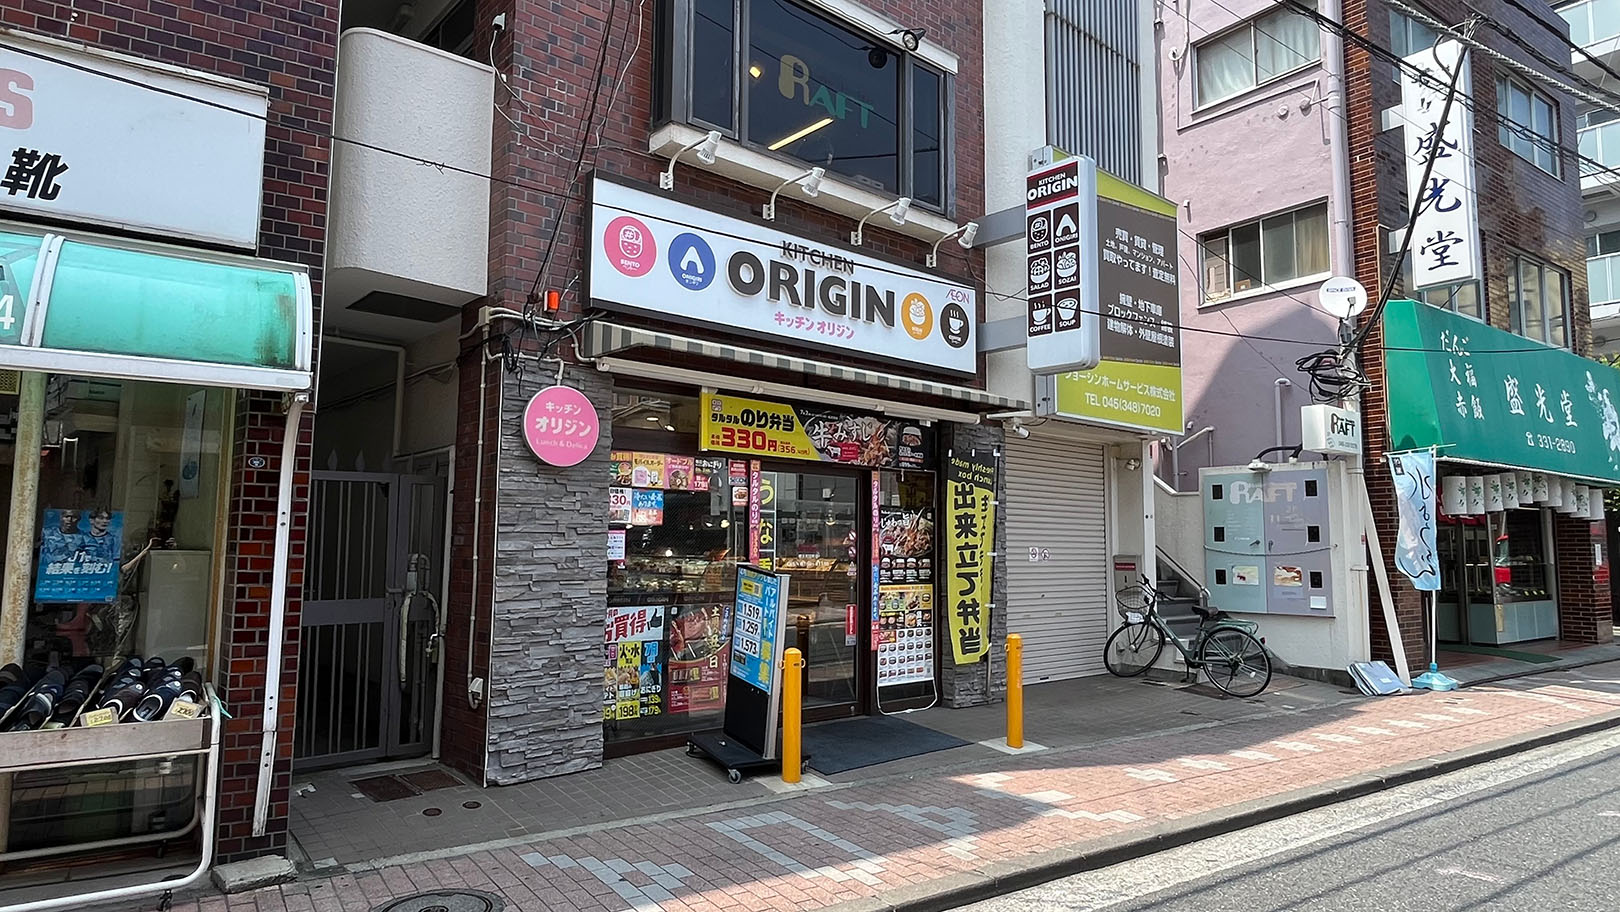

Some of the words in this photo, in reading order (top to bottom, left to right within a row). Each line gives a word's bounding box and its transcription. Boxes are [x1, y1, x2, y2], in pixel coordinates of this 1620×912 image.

[778, 54, 874, 129] RAFT
[1, 147, 68, 201] 靴
[1038, 172, 1066, 186] KITCHEN
[1027, 175, 1078, 201] ORIGIN
[1030, 240, 1049, 250] BENTO
[1054, 233, 1078, 243] ONIGIRI
[619, 258, 641, 269] BENTO
[780, 240, 855, 275] KITCHEN
[727, 250, 896, 329] ORIGIN
[1030, 282, 1049, 291] SALAD
[1058, 276, 1077, 285] SOZAI
[774, 312, 815, 331] キッチン
[816, 321, 855, 340] オリジン
[1029, 324, 1051, 333] COFFEE
[1058, 319, 1076, 328] SOUP
[1440, 330, 1471, 357] だんご
[1449, 358, 1478, 388] 大福
[545, 401, 582, 415] キッチン
[1084, 392, 1101, 407] TEL
[1102, 396, 1161, 417] 045(348)7020
[1455, 390, 1485, 420] 赤飯
[1503, 374, 1578, 427] 盛光堂
[535, 416, 592, 437] オリジン
[711, 408, 795, 433] タルタルのり弁当
[1330, 413, 1356, 437] RAFT
[1537, 434, 1576, 454] 331-2890
[1229, 481, 1298, 504] RAFT
[768, 587, 777, 639] アルバイト
